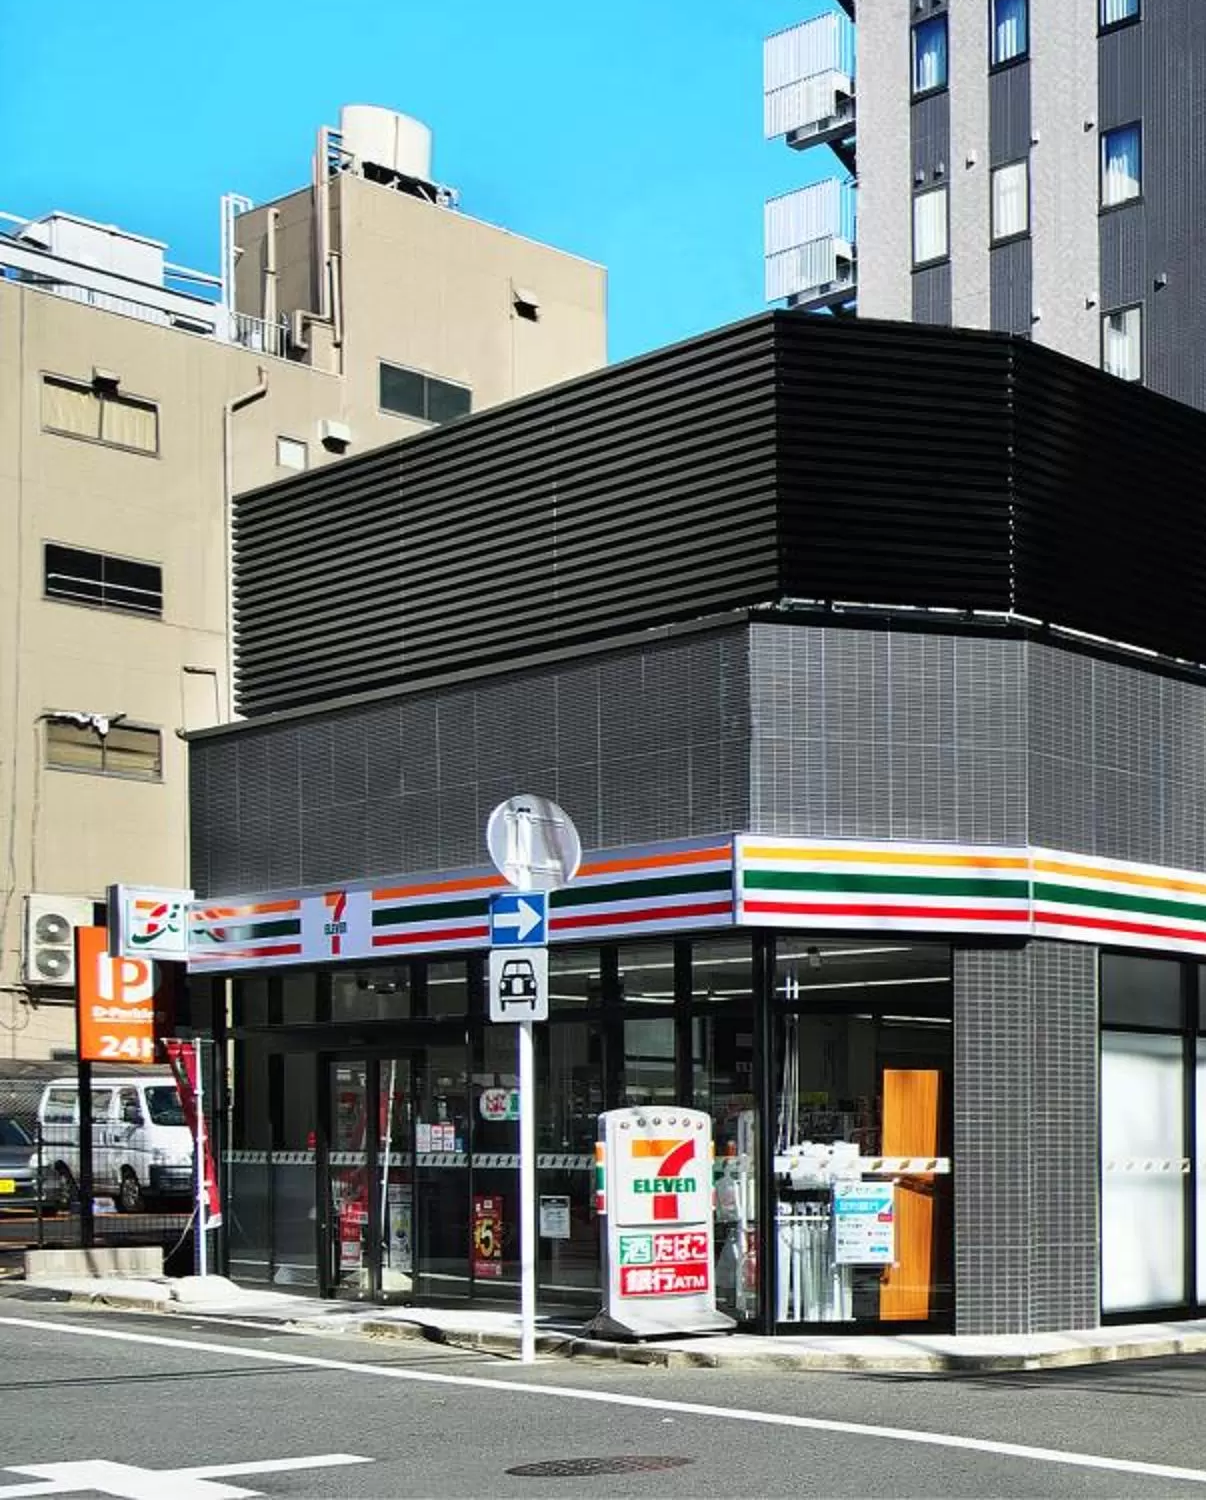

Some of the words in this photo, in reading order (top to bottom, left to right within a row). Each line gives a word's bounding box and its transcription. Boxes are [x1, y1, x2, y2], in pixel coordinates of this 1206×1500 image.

[632, 1139, 695, 1220] 7
[622, 1236, 652, 1264] 酒
[655, 1233, 708, 1262] たばこ
